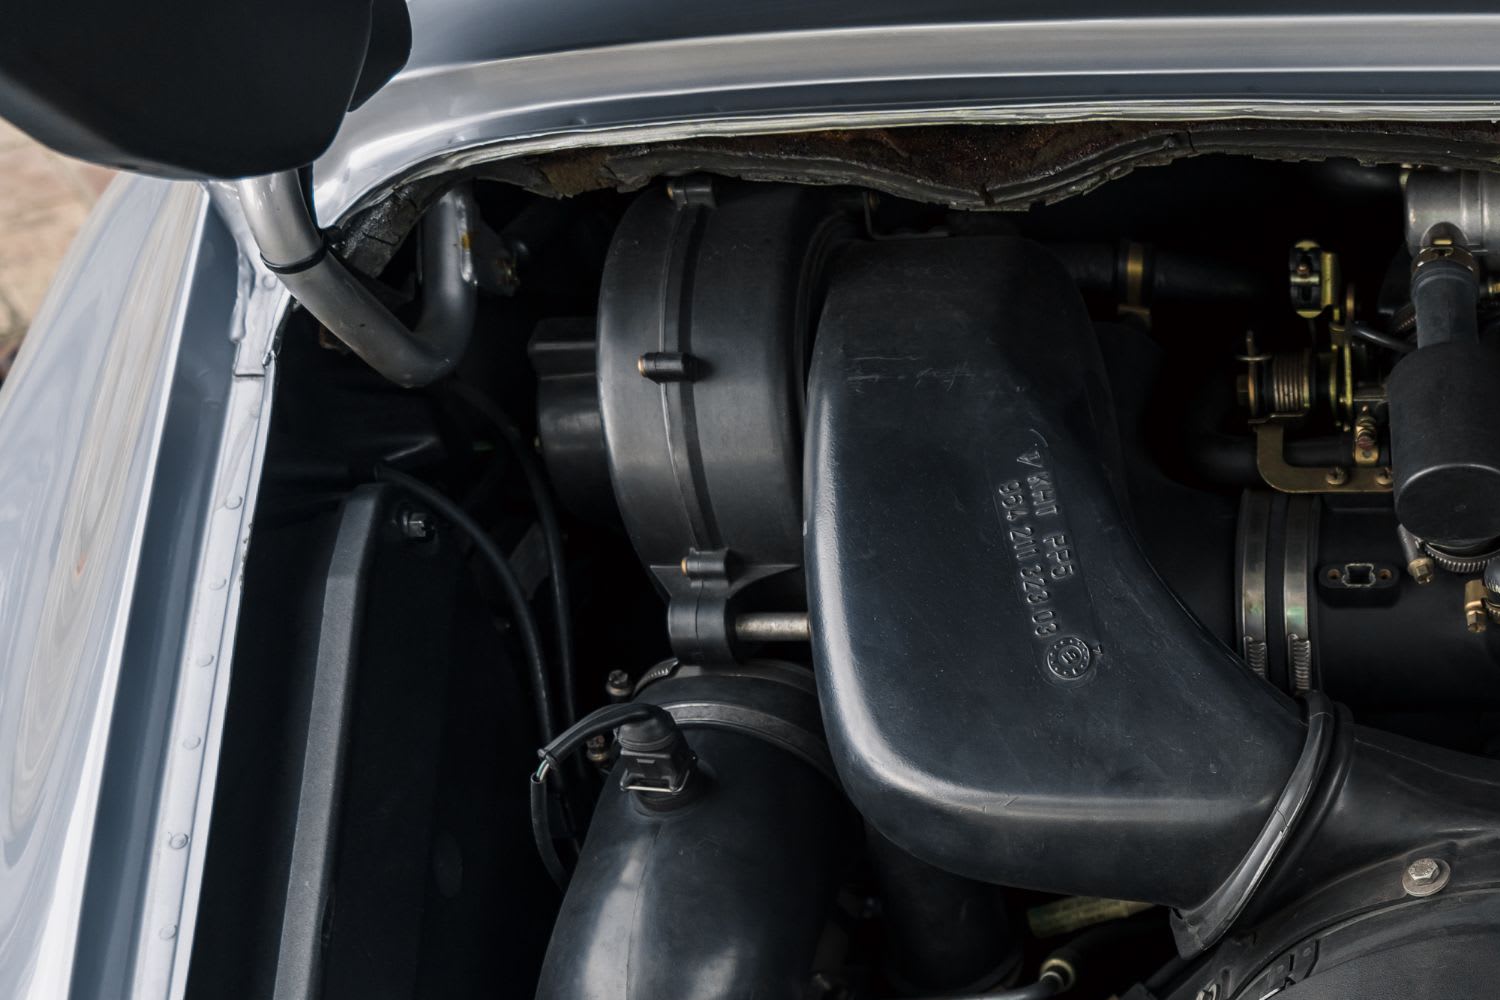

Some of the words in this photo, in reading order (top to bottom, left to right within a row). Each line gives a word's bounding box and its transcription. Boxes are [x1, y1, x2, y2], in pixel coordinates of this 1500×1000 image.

[999, 479, 1028, 522] 964
[1020, 564, 1051, 605] 323
[1032, 610, 1058, 638] 03
